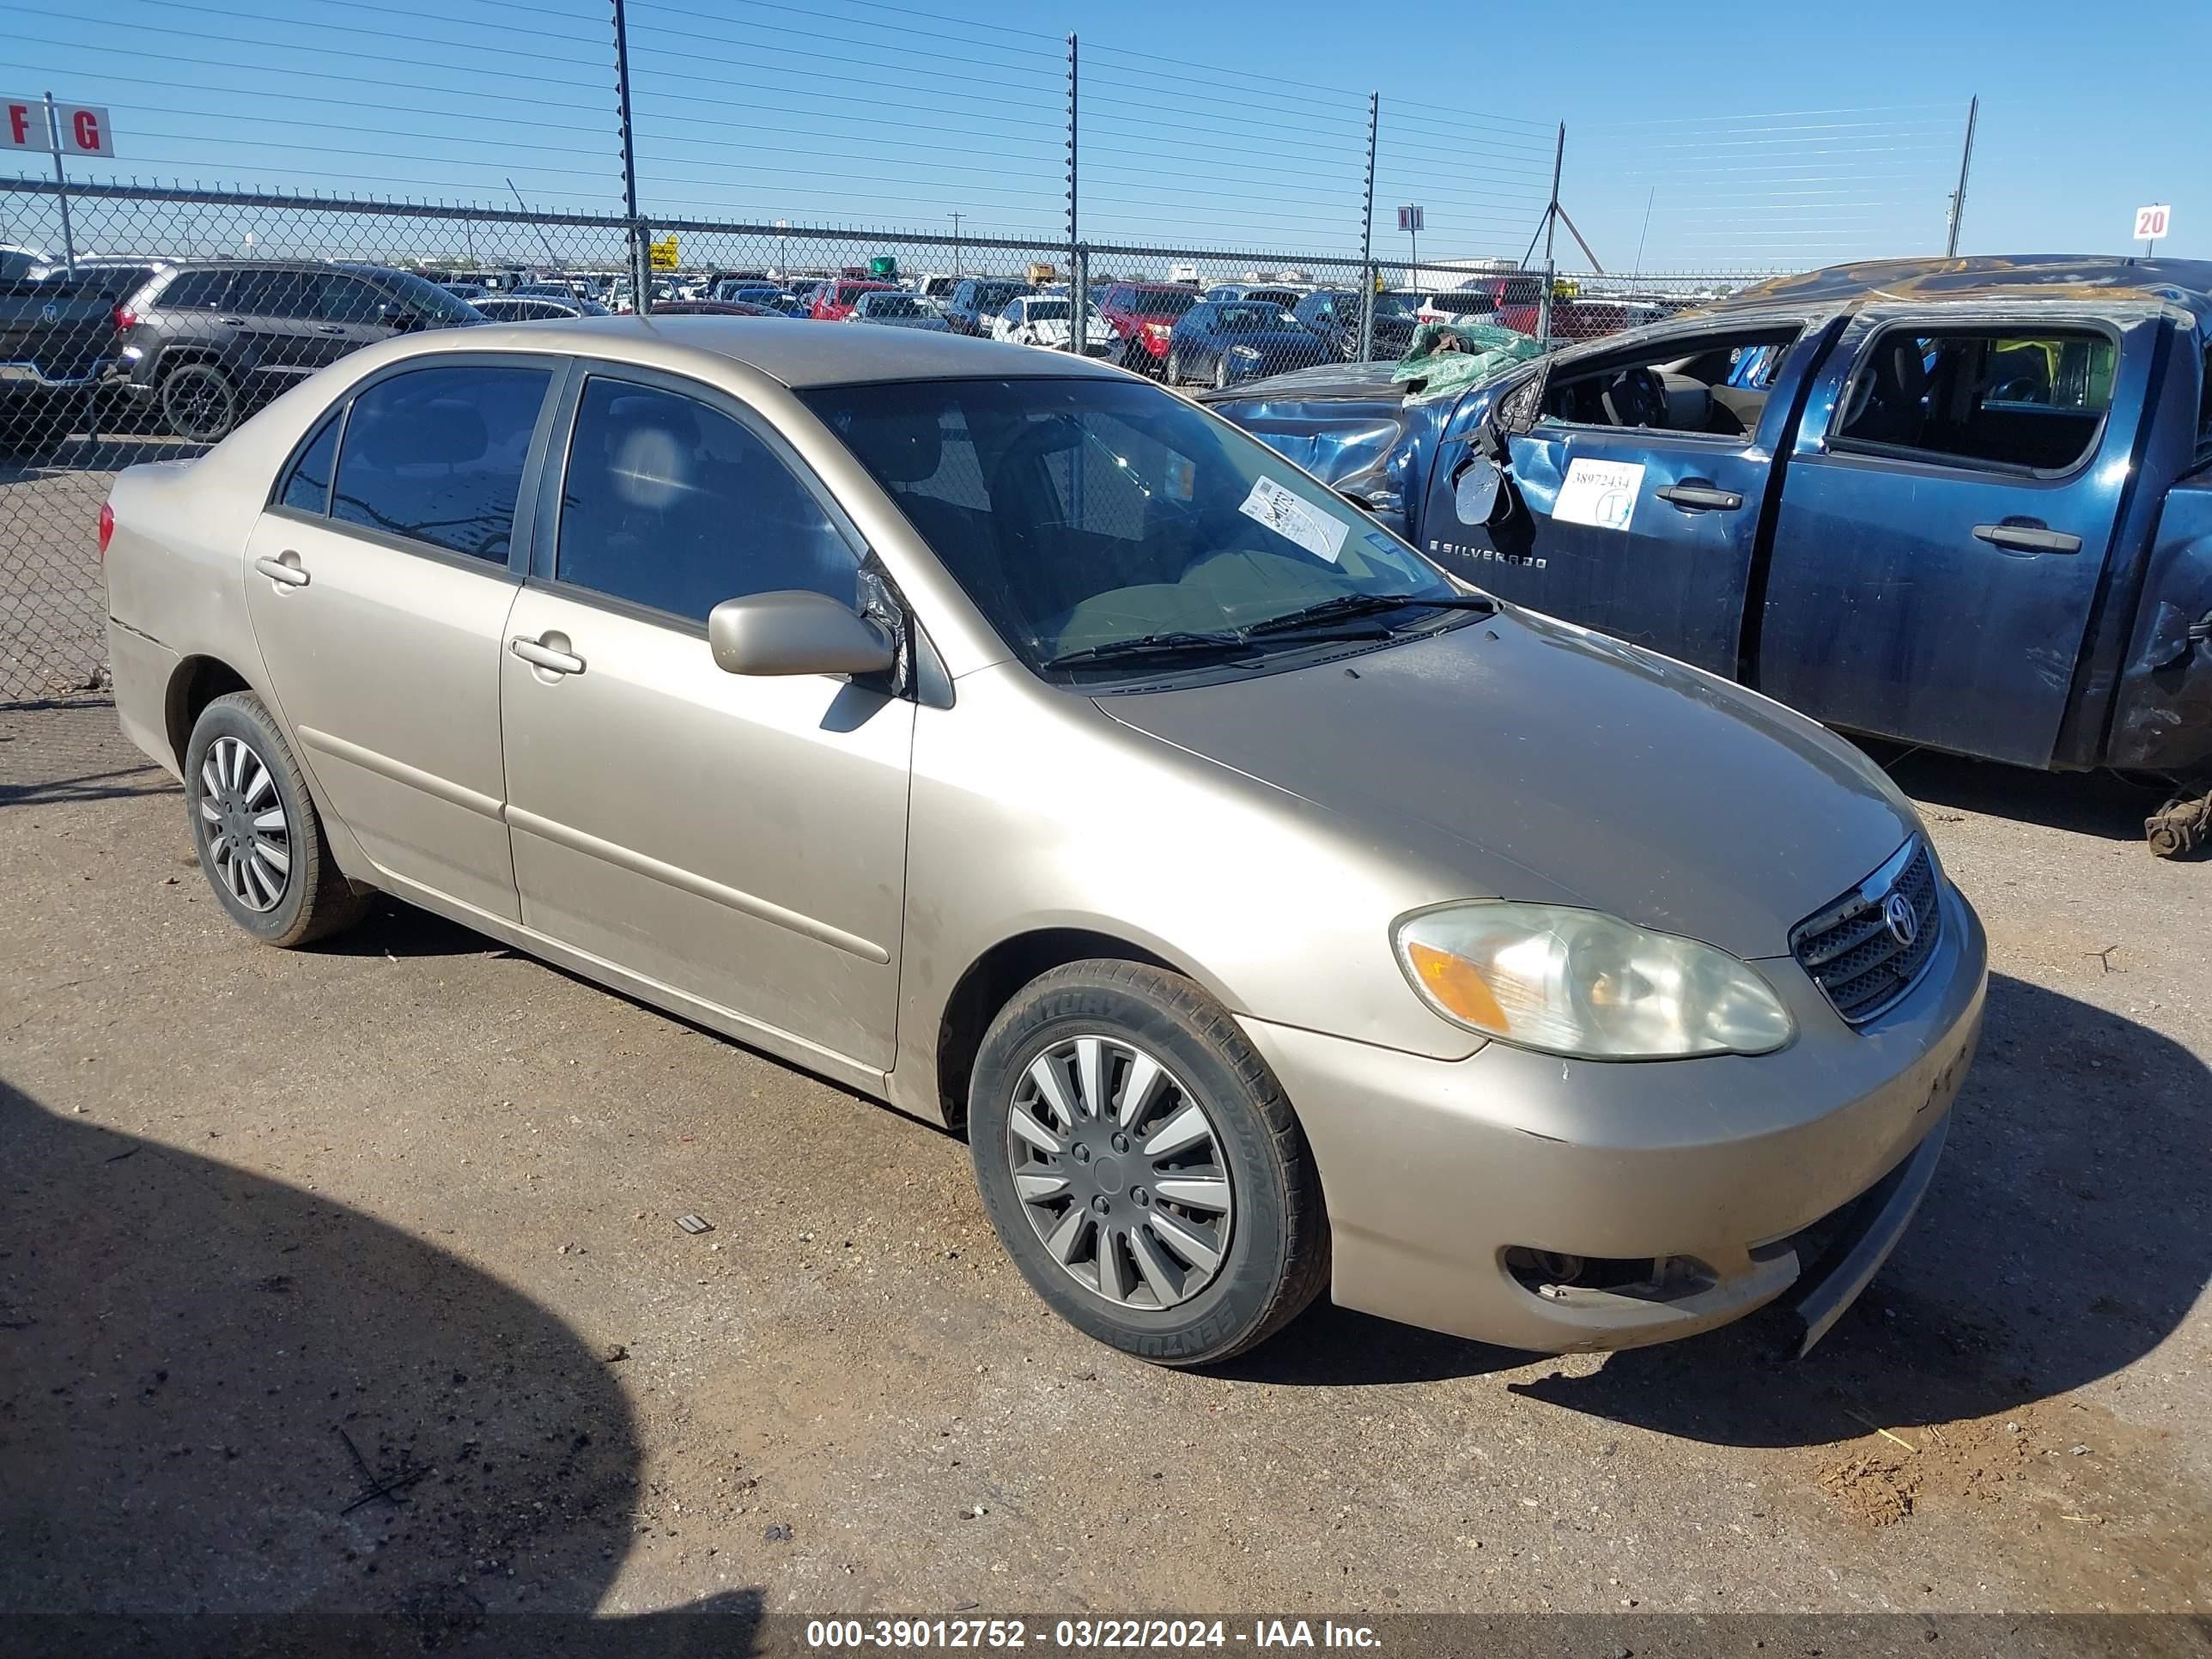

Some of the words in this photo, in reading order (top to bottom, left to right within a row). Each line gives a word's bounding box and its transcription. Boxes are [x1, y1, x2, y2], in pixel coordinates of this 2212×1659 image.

[9, 105, 29, 144] F
[73, 110, 100, 150] G
[2138, 211, 2165, 234] 20
[1442, 543, 1547, 569] SILVERADO
